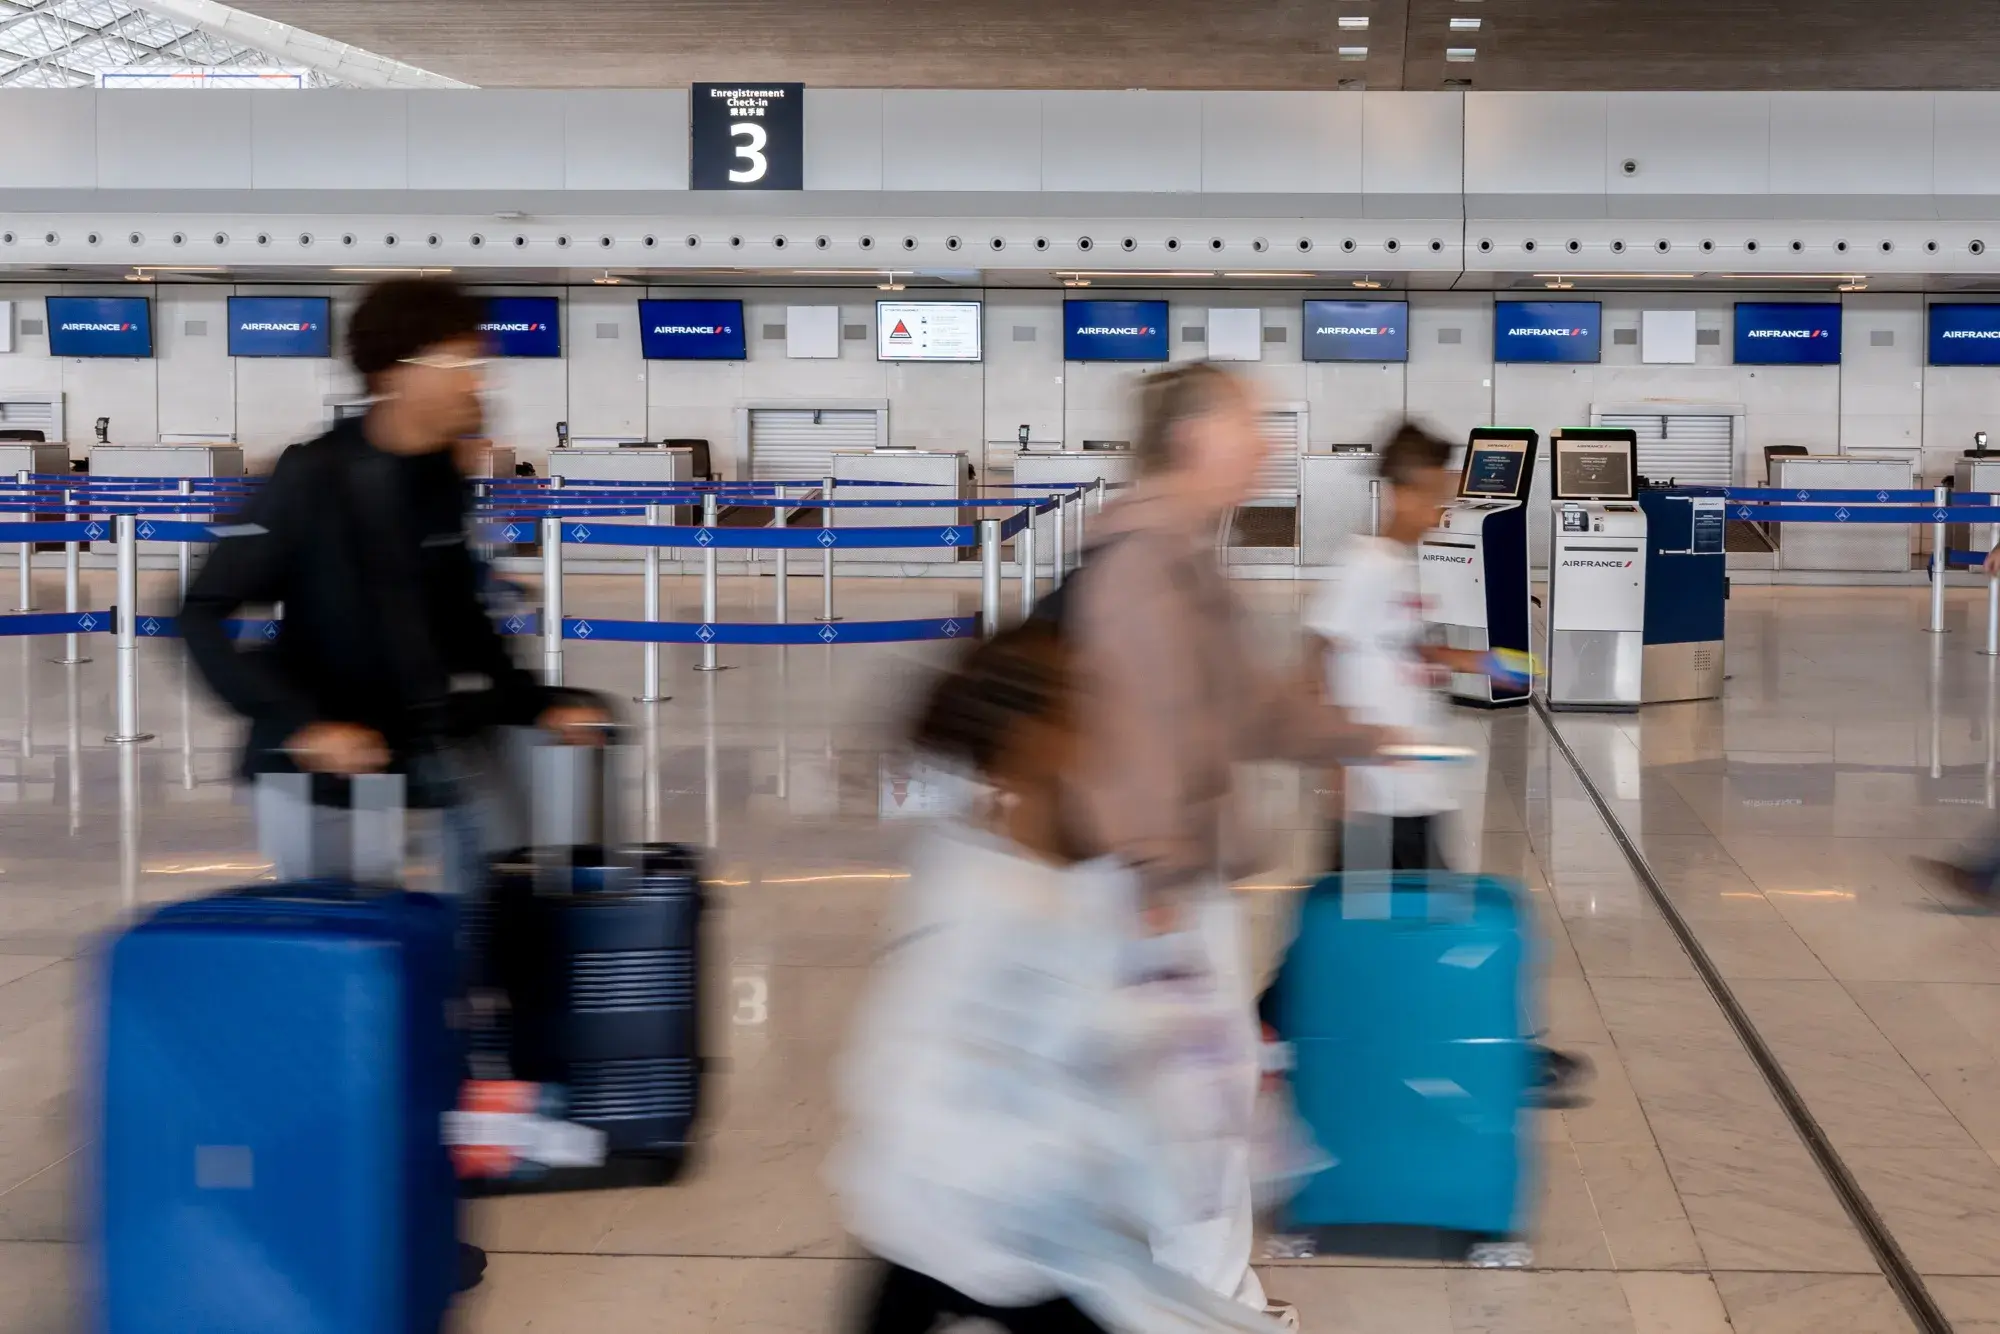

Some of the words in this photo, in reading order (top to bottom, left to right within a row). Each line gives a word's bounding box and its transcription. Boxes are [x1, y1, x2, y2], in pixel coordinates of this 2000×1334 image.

[710, 88, 785, 99] Enregistrement
[726, 98, 769, 107] Check-in
[728, 122, 768, 184] 3
[61, 323, 121, 331] AIRFRANCE
[240, 323, 300, 331] AIRFRANCE
[475, 323, 529, 331] IRFRANCE
[654, 326, 714, 334] AIRFRANCE
[1077, 327, 1138, 335] AIRFRANCE
[1316, 326, 1378, 335] AIRFRANCE
[1508, 326, 1570, 335] AIRFRANCE
[1748, 330, 1810, 338] AIRFRANCE
[1422, 554, 1466, 564] AIRFRANCE
[1561, 560, 1623, 568] AIRFRANCE
